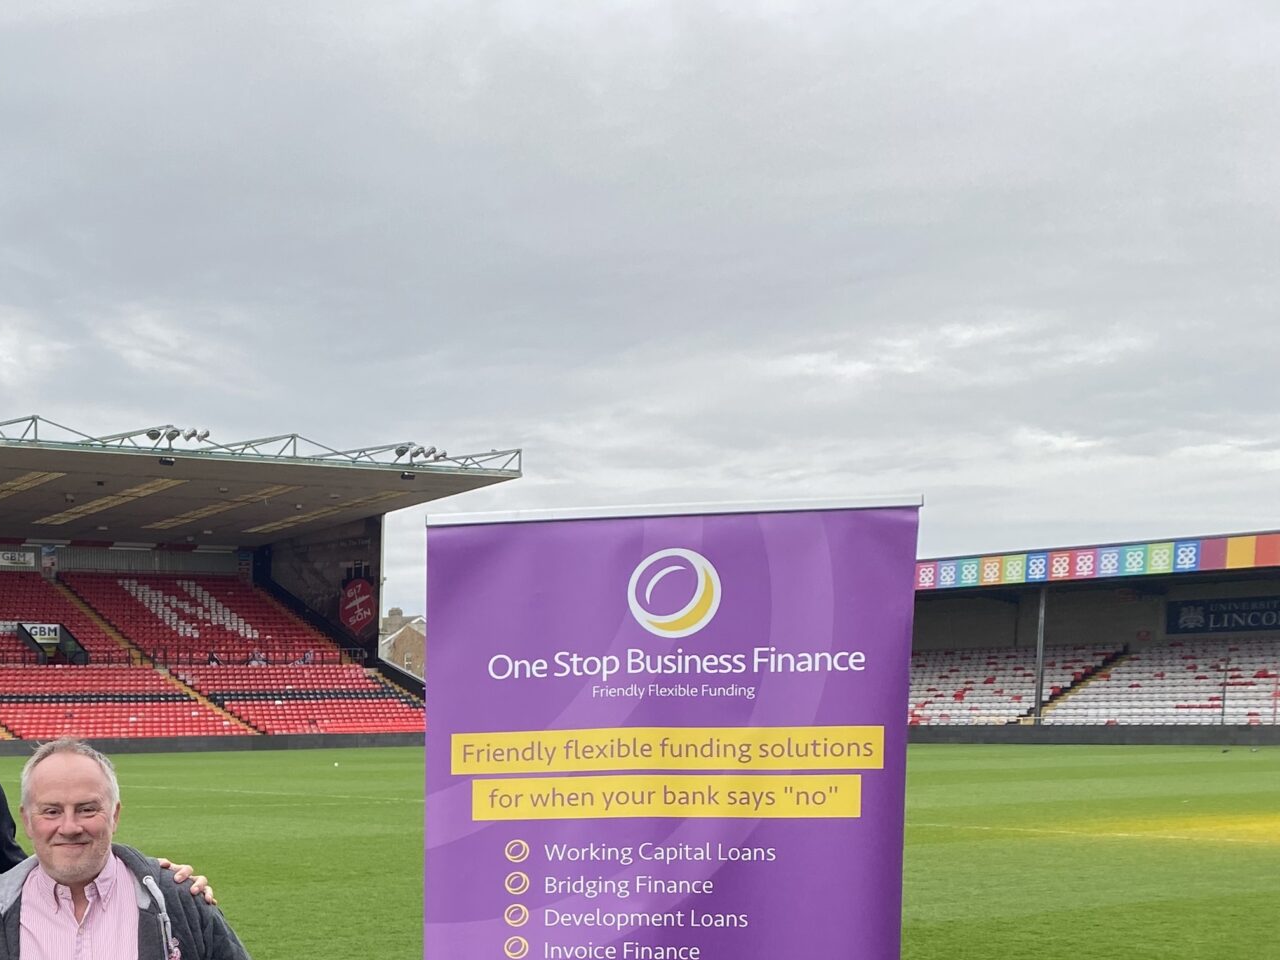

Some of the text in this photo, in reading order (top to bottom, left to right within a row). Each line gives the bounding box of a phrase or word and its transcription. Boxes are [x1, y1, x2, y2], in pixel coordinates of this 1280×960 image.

[1, 552, 27, 562] GBM
[30, 626, 58, 637] GBM
[1209, 611, 1280, 629] LINCO
[488, 646, 866, 682] One Stop Business Finance
[592, 683, 756, 700] Friendly Flexible Funding
[463, 737, 874, 766] Friendly flexible funding solutions
[488, 784, 838, 811] for when your bank says "no"
[544, 842, 776, 866] Working Capital Loans
[545, 875, 715, 899] Bridging Finance
[544, 908, 748, 931] Development Loans
[544, 941, 700, 960] Invoice Finance
